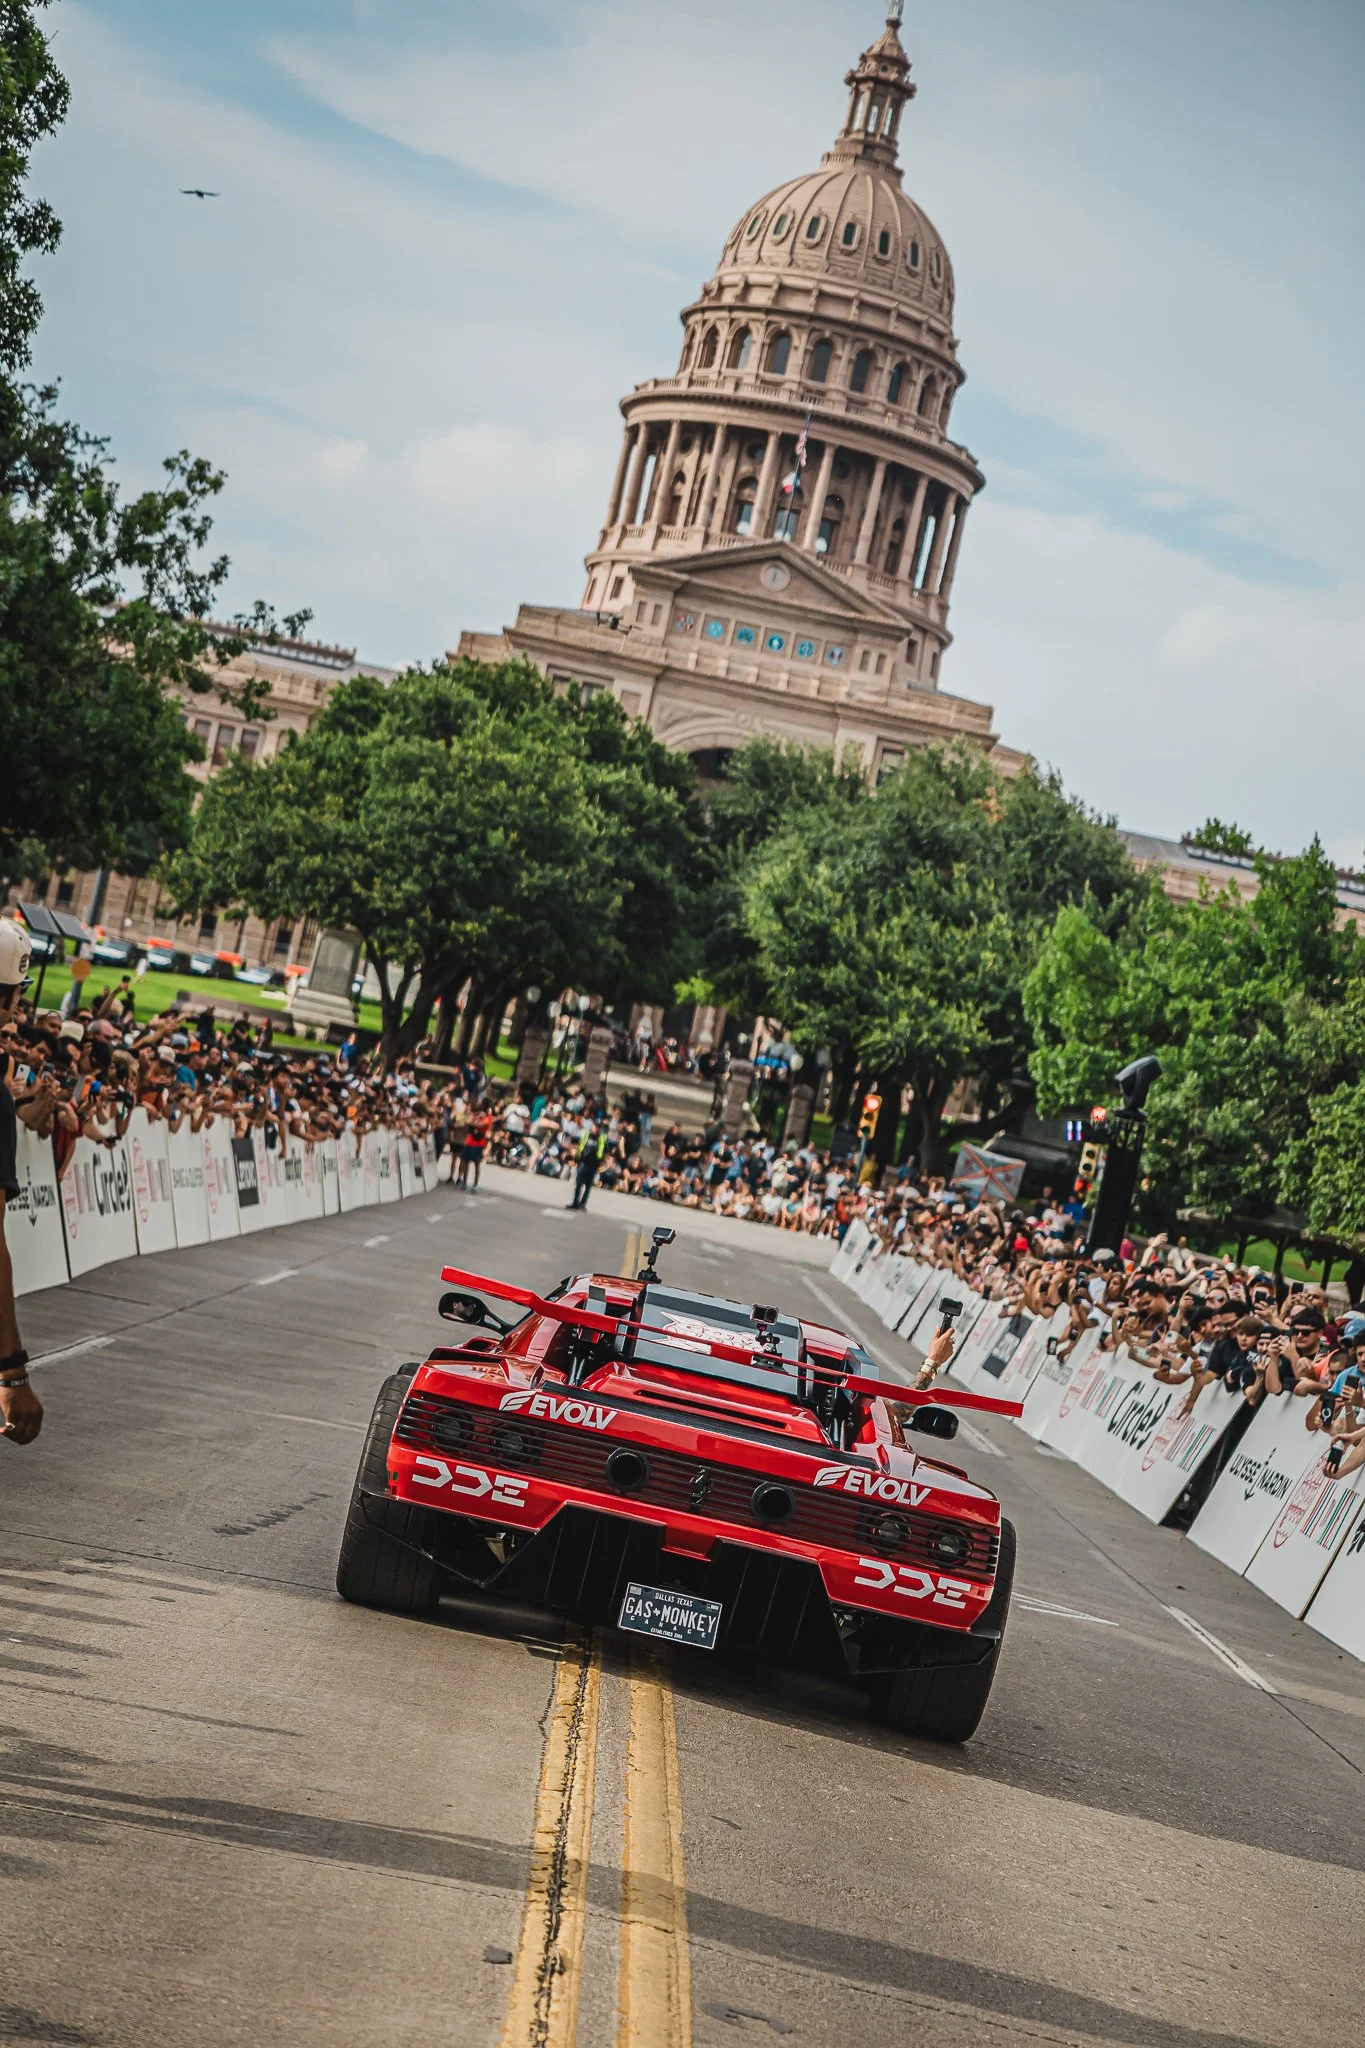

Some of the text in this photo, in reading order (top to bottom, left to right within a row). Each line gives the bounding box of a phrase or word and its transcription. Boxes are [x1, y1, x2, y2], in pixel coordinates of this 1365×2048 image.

[529, 1395, 617, 1430] EVOLV
[412, 1455, 529, 1508] DDE
[843, 1469, 932, 1507] EVOLV
[1229, 1452, 1293, 1500] ULYSSE NARDIN
[655, 1592, 693, 1607] DALLAS TEXAS
[854, 1557, 972, 1609] DDE
[626, 1597, 716, 1633] GAS MONKEY
[630, 1615, 706, 1638] GARAGE
